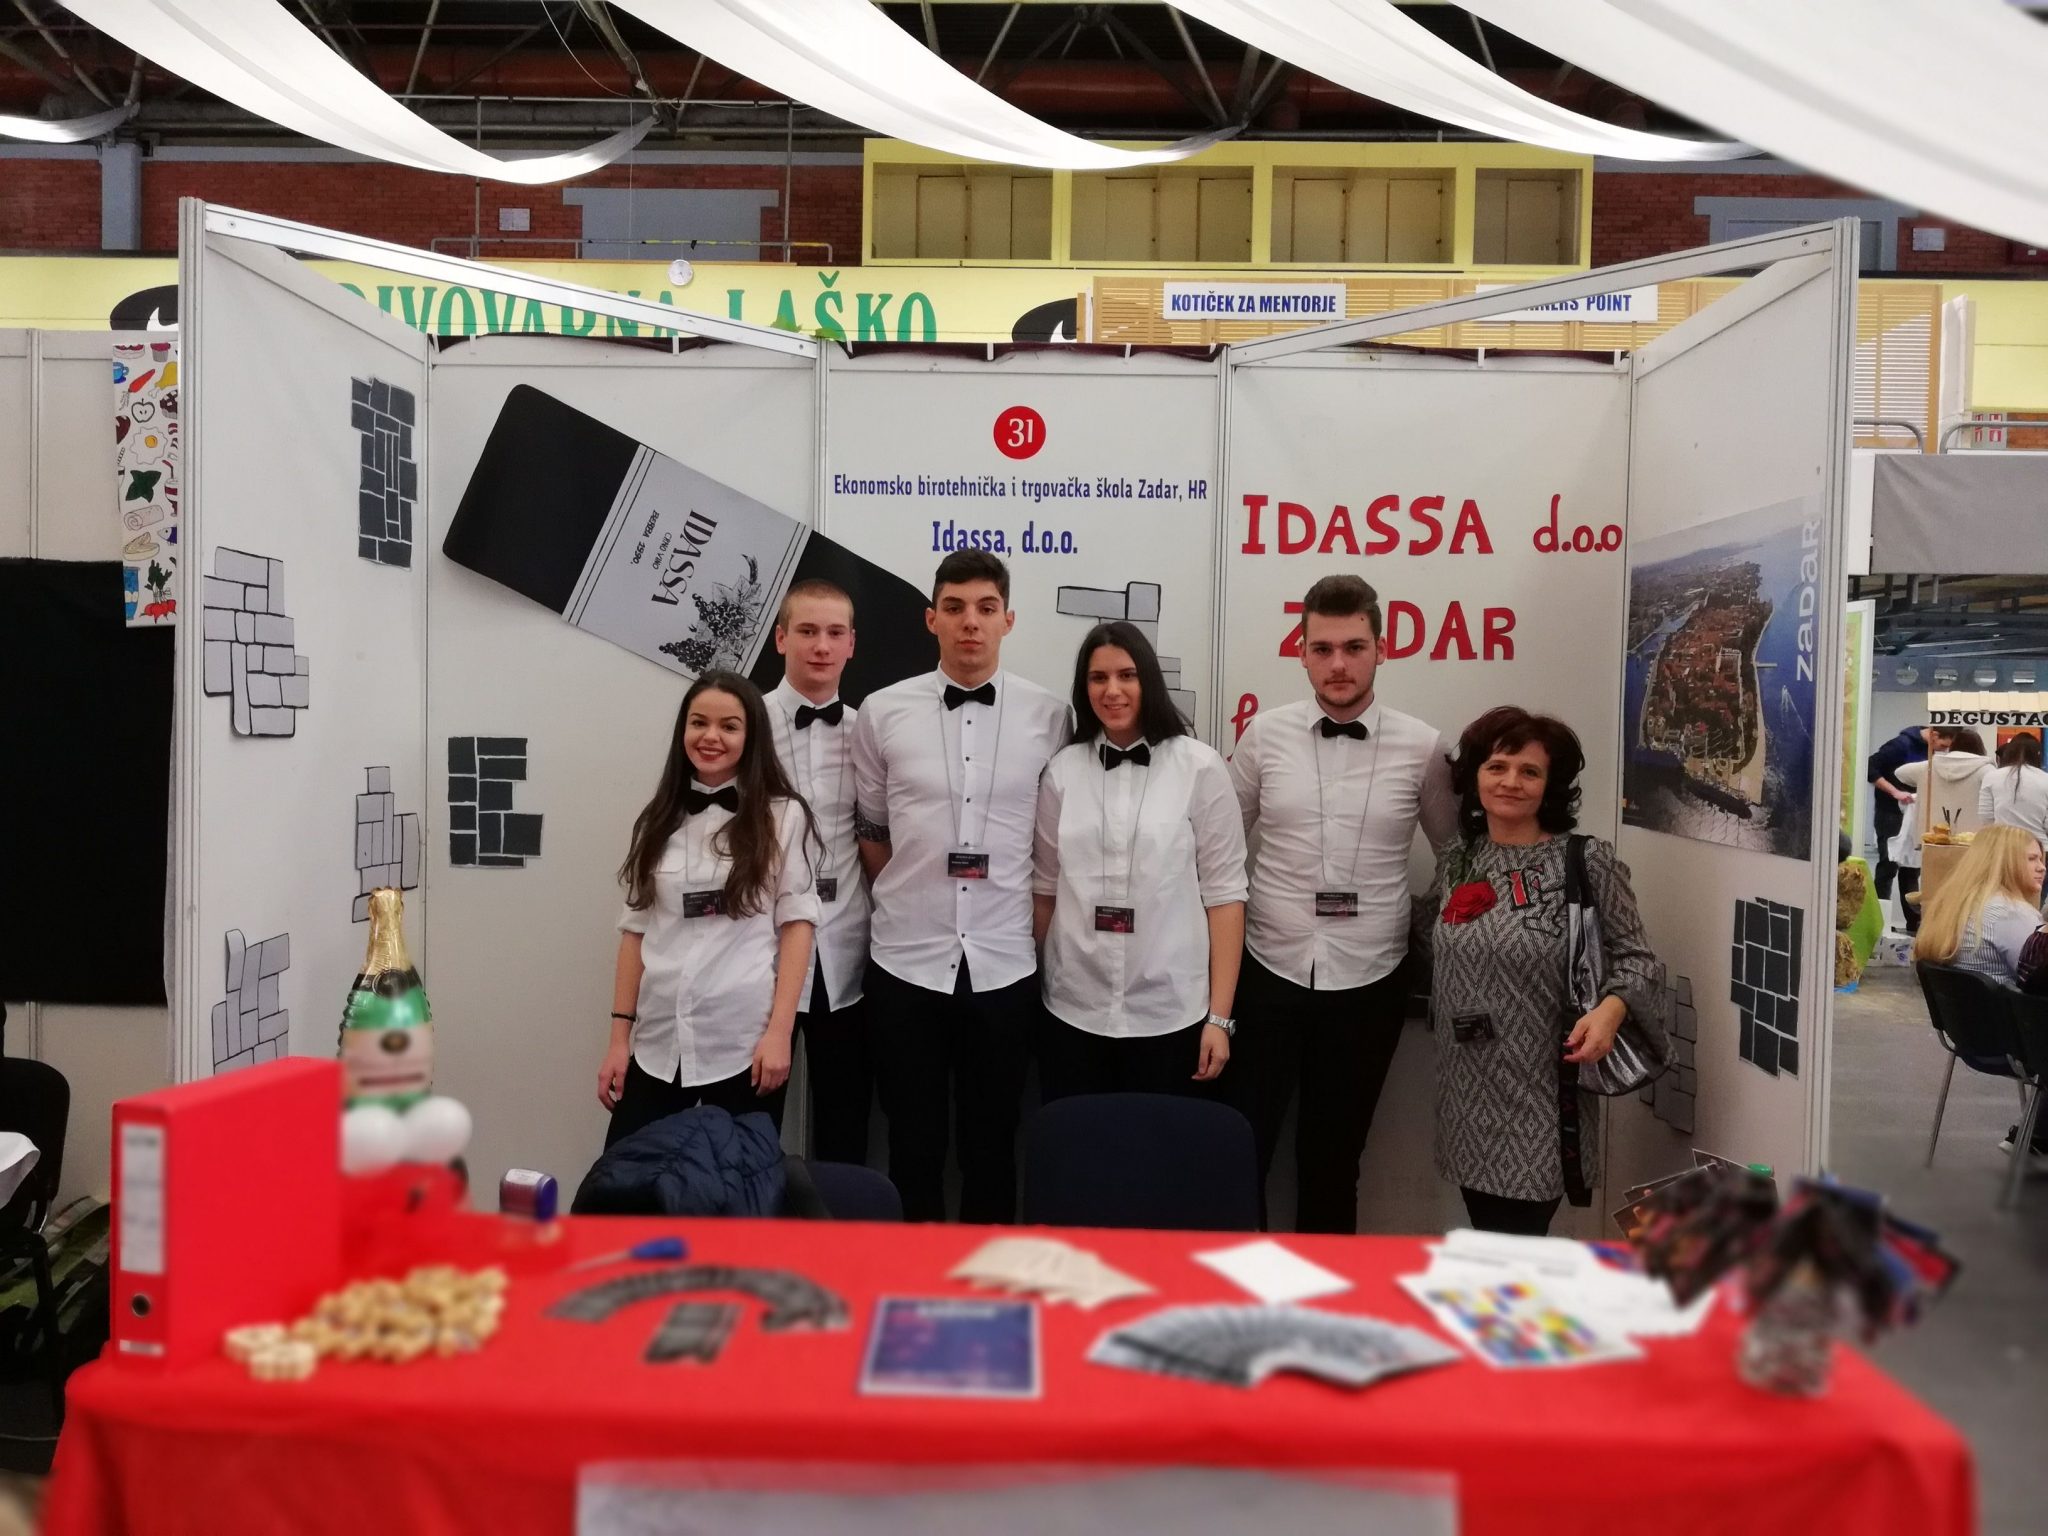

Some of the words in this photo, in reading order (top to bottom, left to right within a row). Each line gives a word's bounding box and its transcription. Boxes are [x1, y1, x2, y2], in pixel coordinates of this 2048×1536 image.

[1171, 290, 1235, 312] KOTIČEK
[1238, 295, 1256, 312] ZA
[1259, 295, 1337, 312] MENTORJE
[1586, 294, 1632, 311] POINT
[1007, 418, 1034, 448] 31
[834, 474, 912, 495] Ekonomsko
[918, 475, 1006, 497] birotehnička
[1011, 476, 1017, 497] i
[1022, 476, 1090, 503] trgovačka
[1096, 477, 1133, 498] škola
[1138, 478, 1183, 502] Zadar,
[1188, 479, 1207, 499] HR
[932, 519, 1012, 557] Idassa,
[1022, 521, 1078, 554] d.o.o.
[1242, 494, 1494, 555] IDASSA
[1533, 493, 1623, 553] d.o.o
[651, 509, 718, 606] IDASSA
[1278, 600, 1517, 661] ZDAR
